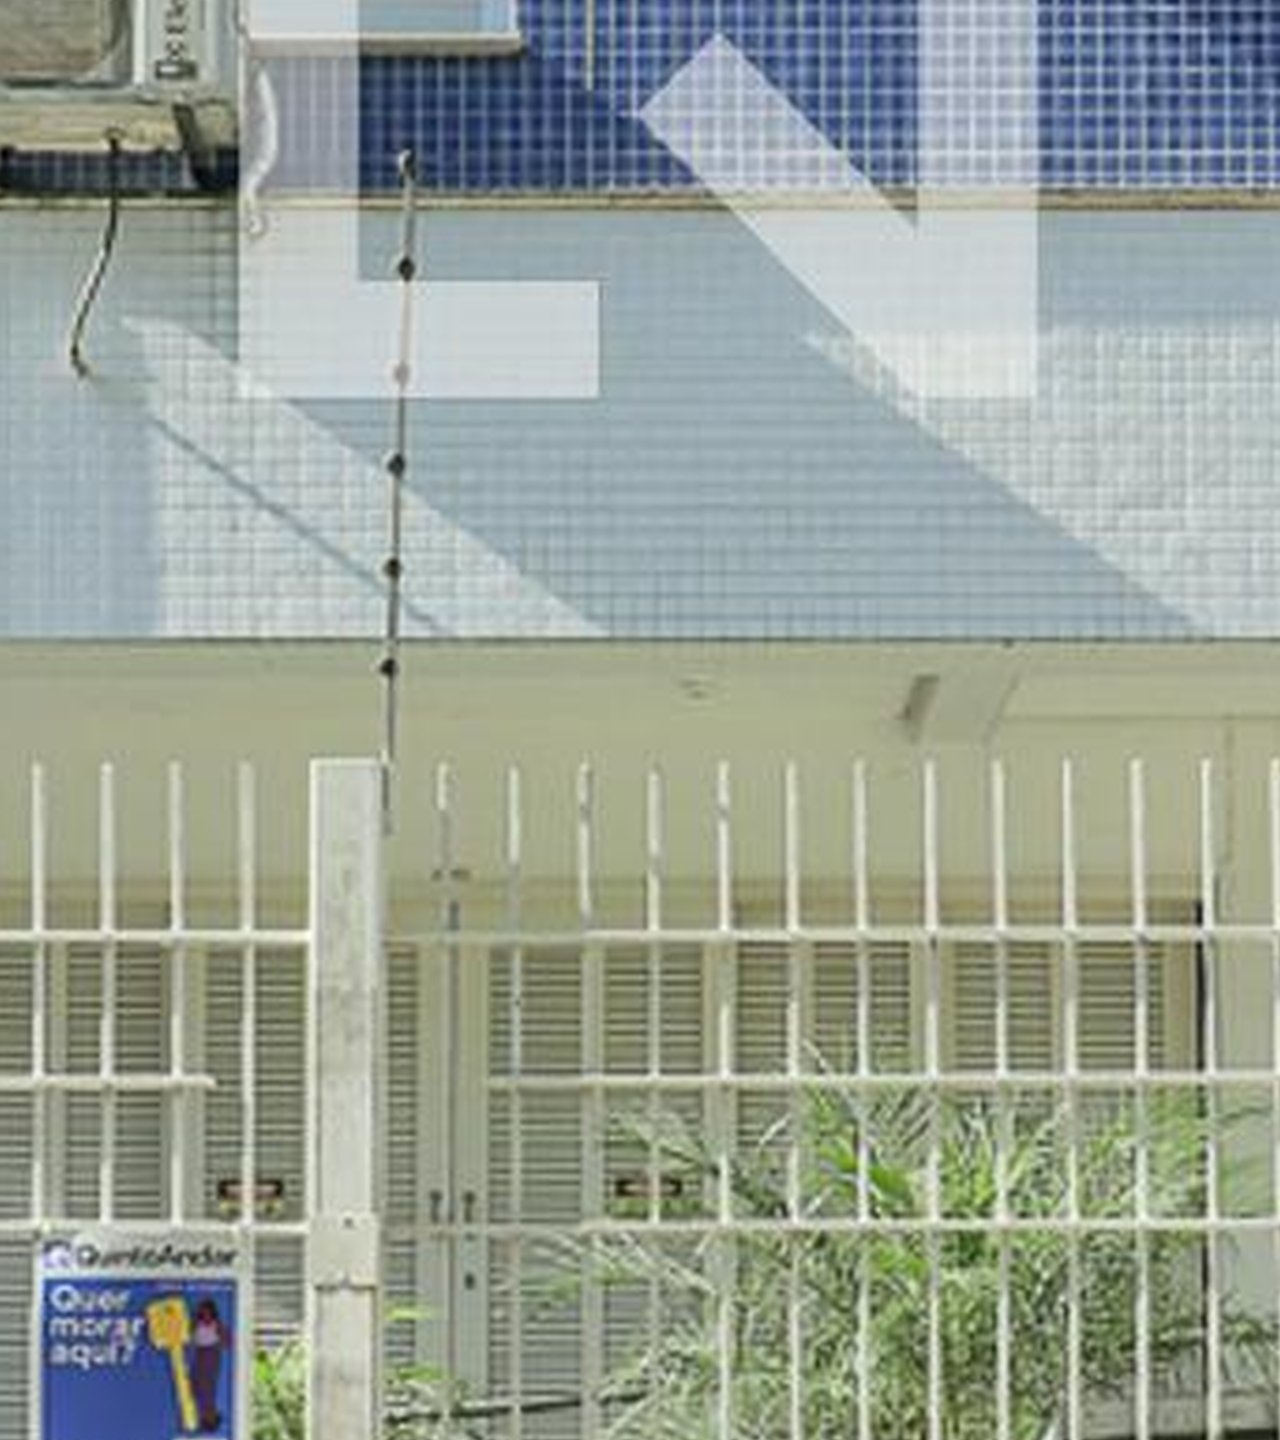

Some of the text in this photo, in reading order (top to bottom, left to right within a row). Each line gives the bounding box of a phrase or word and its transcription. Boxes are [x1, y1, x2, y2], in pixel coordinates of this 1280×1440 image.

[76, 1244, 238, 1267] QuintoAndar
[49, 1283, 132, 1312] Quer
[49, 1317, 145, 1337] morar
